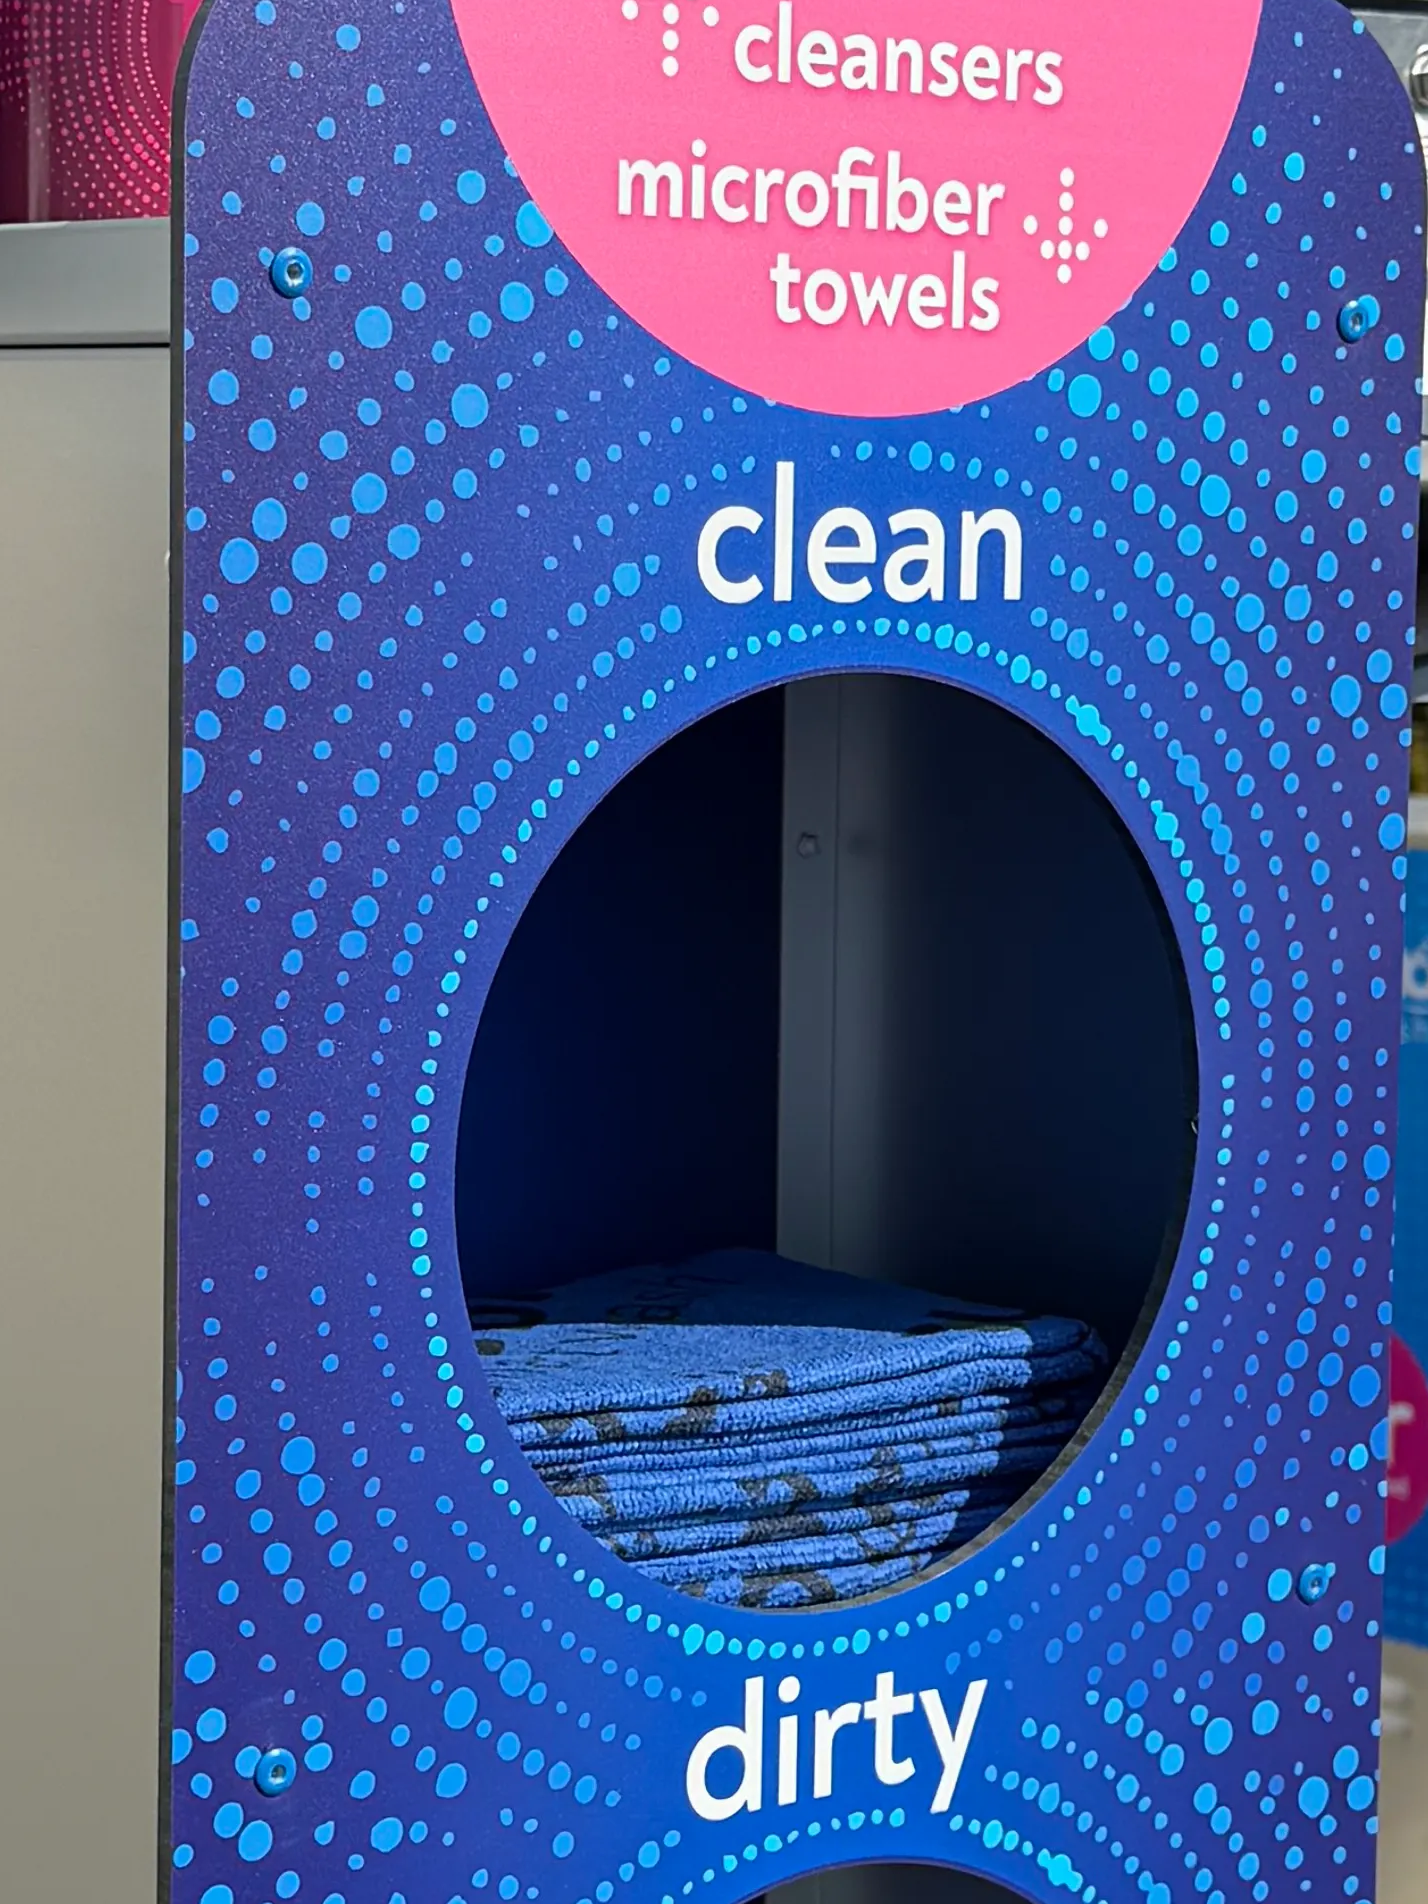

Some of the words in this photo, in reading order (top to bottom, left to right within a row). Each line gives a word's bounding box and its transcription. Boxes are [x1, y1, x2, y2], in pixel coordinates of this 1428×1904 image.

[734, 0, 1063, 106] cleansers
[618, 139, 1005, 236] microfiber
[770, 251, 1000, 331] towels
[697, 461, 1023, 604] clean
[686, 1671, 988, 1821] dirty
